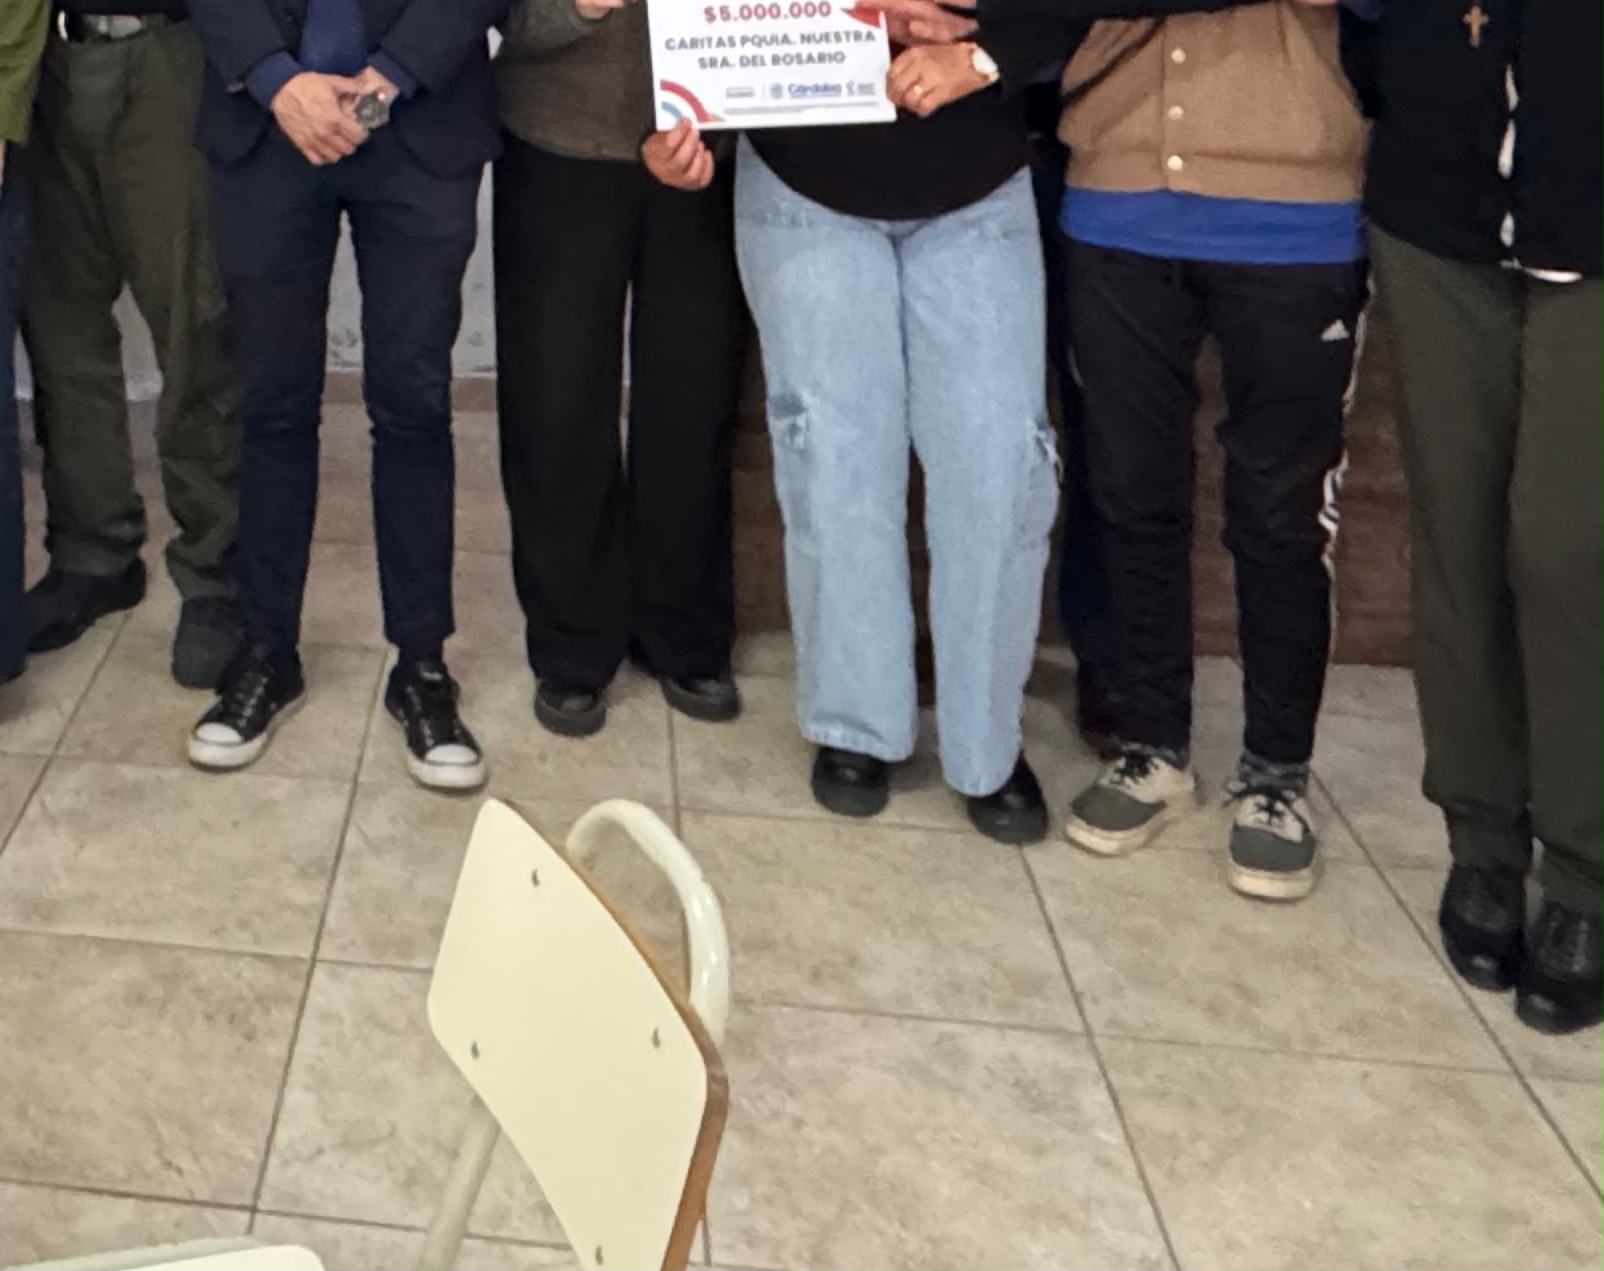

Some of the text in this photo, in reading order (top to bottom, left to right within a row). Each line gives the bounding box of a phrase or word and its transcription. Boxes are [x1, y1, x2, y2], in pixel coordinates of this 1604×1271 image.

[703, 0, 832, 24] $5.000.000
[664, 29, 877, 51] CARITAS PQUIA. NUESTRA
[697, 50, 846, 70] SRA. DEL ROSARIO
